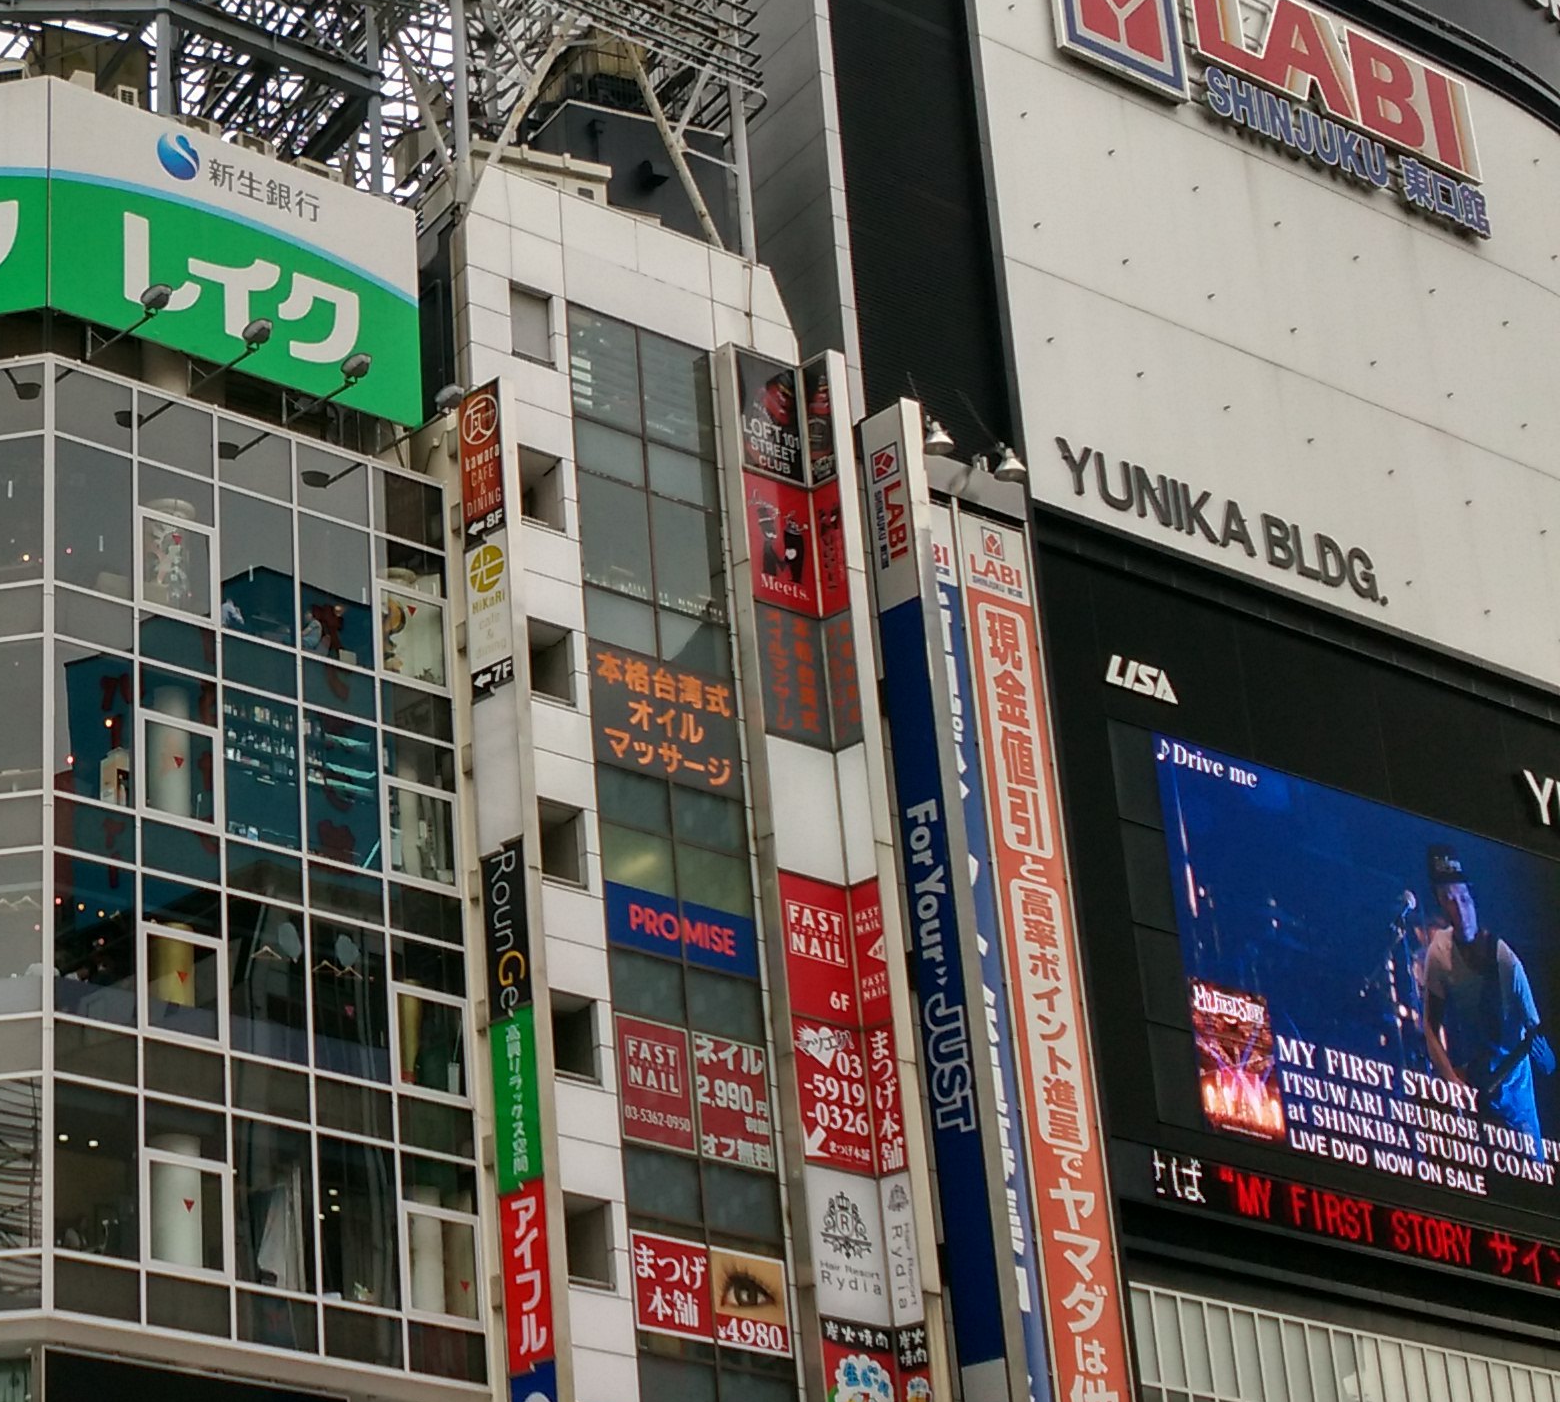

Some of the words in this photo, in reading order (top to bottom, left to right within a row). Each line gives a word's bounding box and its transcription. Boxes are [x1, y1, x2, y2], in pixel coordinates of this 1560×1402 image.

[1204, 65, 1389, 188] SHINJUKU
[1400, 154, 1493, 241] 東口館
[207, 157, 322, 224] 新生銀行
[122, 211, 361, 364] レイク
[741, 413, 783, 444] LOFT
[750, 437, 797, 463] STREET
[464, 442, 500, 473] kawara
[758, 454, 791, 476] CLUB
[466, 489, 502, 518] DINING
[485, 508, 504, 529] 8F
[882, 479, 910, 561] LABI
[1054, 435, 1257, 558] YUNIKA
[1261, 512, 1390, 607] BLDG.
[969, 551, 1023, 590] LABI
[490, 658, 513, 683] 7F
[596, 649, 733, 720] 本格台湾式
[628, 700, 705, 747] オイル
[603, 725, 733, 789] マッサージ
[1172, 743, 1225, 778] Drive
[1229, 762, 1259, 789] me
[905, 797, 941, 868] For
[628, 903, 737, 958] PROMISE
[789, 904, 842, 937] FAST
[912, 863, 947, 972] Your
[790, 932, 845, 965] NAIL
[829, 990, 850, 1013] 6F
[627, 1038, 678, 1067] FAST
[694, 1036, 764, 1076] ネイル
[837, 1051, 863, 1079] 03
[923, 991, 977, 1133] JUST
[1276, 1034, 1317, 1070] MY
[1324, 1046, 1394, 1091] FIRST
[1402, 1068, 1479, 1113] STORY
[628, 1065, 680, 1094] NAIL
[803, 1073, 866, 1107] -5919
[870, 1030, 905, 1174] まつげ本舗
[806, 1102, 870, 1137] -0326
[1282, 1070, 1384, 1118] ITSUWARI
[1390, 1096, 1479, 1141] NEUROSE
[1484, 1122, 1536, 1157] TOUR
[1287, 1100, 1308, 1121] at
[1313, 1105, 1410, 1150] SHINKIBA
[1416, 1131, 1488, 1169] STUDIO
[1493, 1150, 1557, 1187] COAST
[1290, 1128, 1329, 1156] LIVE
[1332, 1140, 1368, 1166] DVD
[1374, 1150, 1414, 1177] NOW
[1418, 1160, 1442, 1185] ON
[1446, 1169, 1488, 1196] SALE
[1291, 1186, 1374, 1244] FIRST
[1391, 1209, 1472, 1266] STORY
[510, 1198, 547, 1356] アイフル
[634, 1243, 708, 1291] まつげ
[821, 1269, 883, 1297] Rydia
[646, 1285, 700, 1329] 本舗
[825, 1320, 889, 1350] 炭火焼肉
